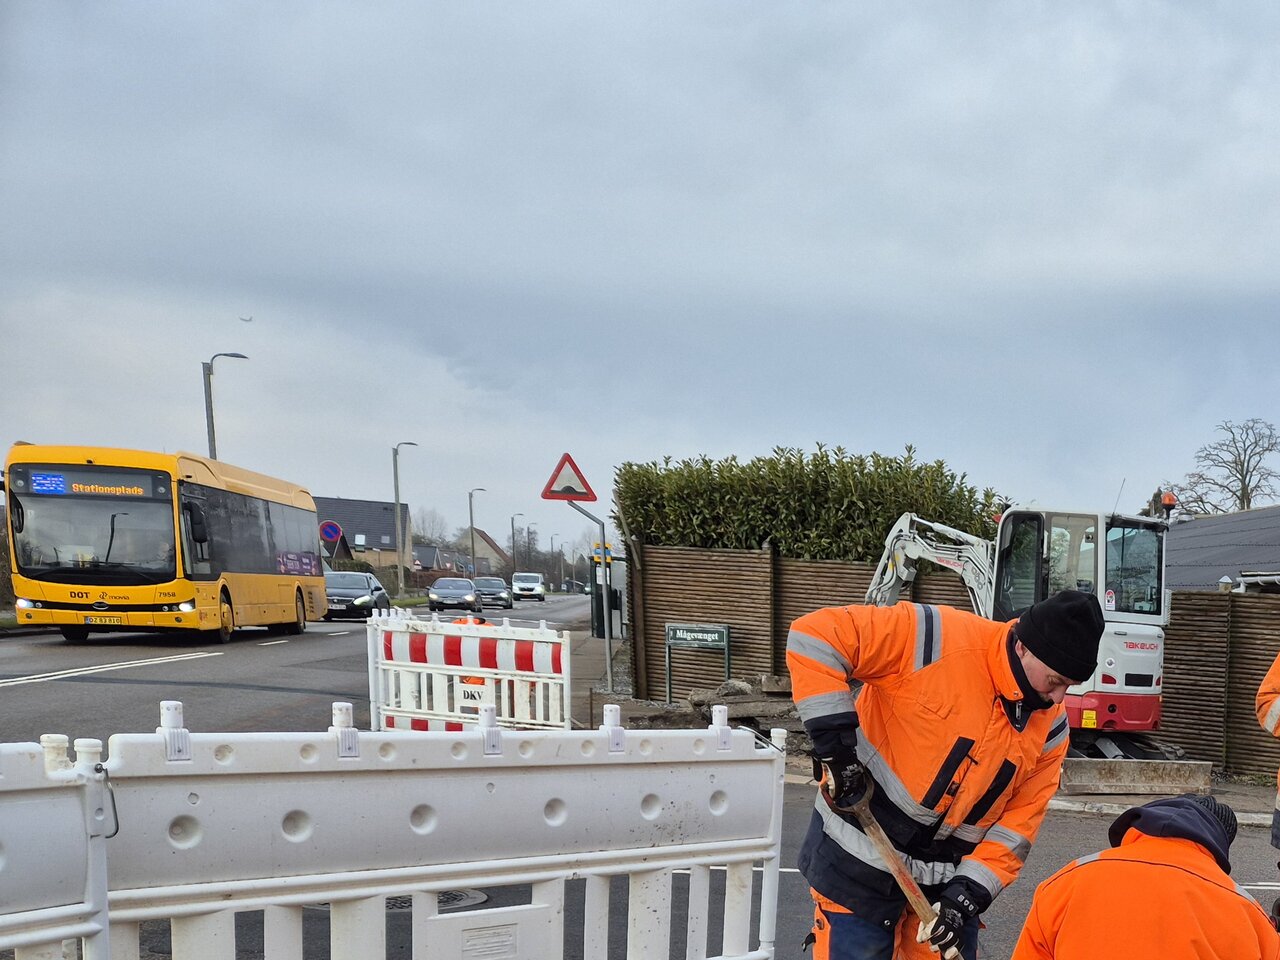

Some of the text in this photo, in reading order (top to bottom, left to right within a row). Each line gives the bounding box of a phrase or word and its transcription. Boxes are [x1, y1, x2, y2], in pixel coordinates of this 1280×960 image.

[72, 483, 144, 495] Stationsplads
[70, 591, 90, 599] DOT
[676, 630, 718, 641] Mågevænget
[463, 690, 483, 700] DKV
